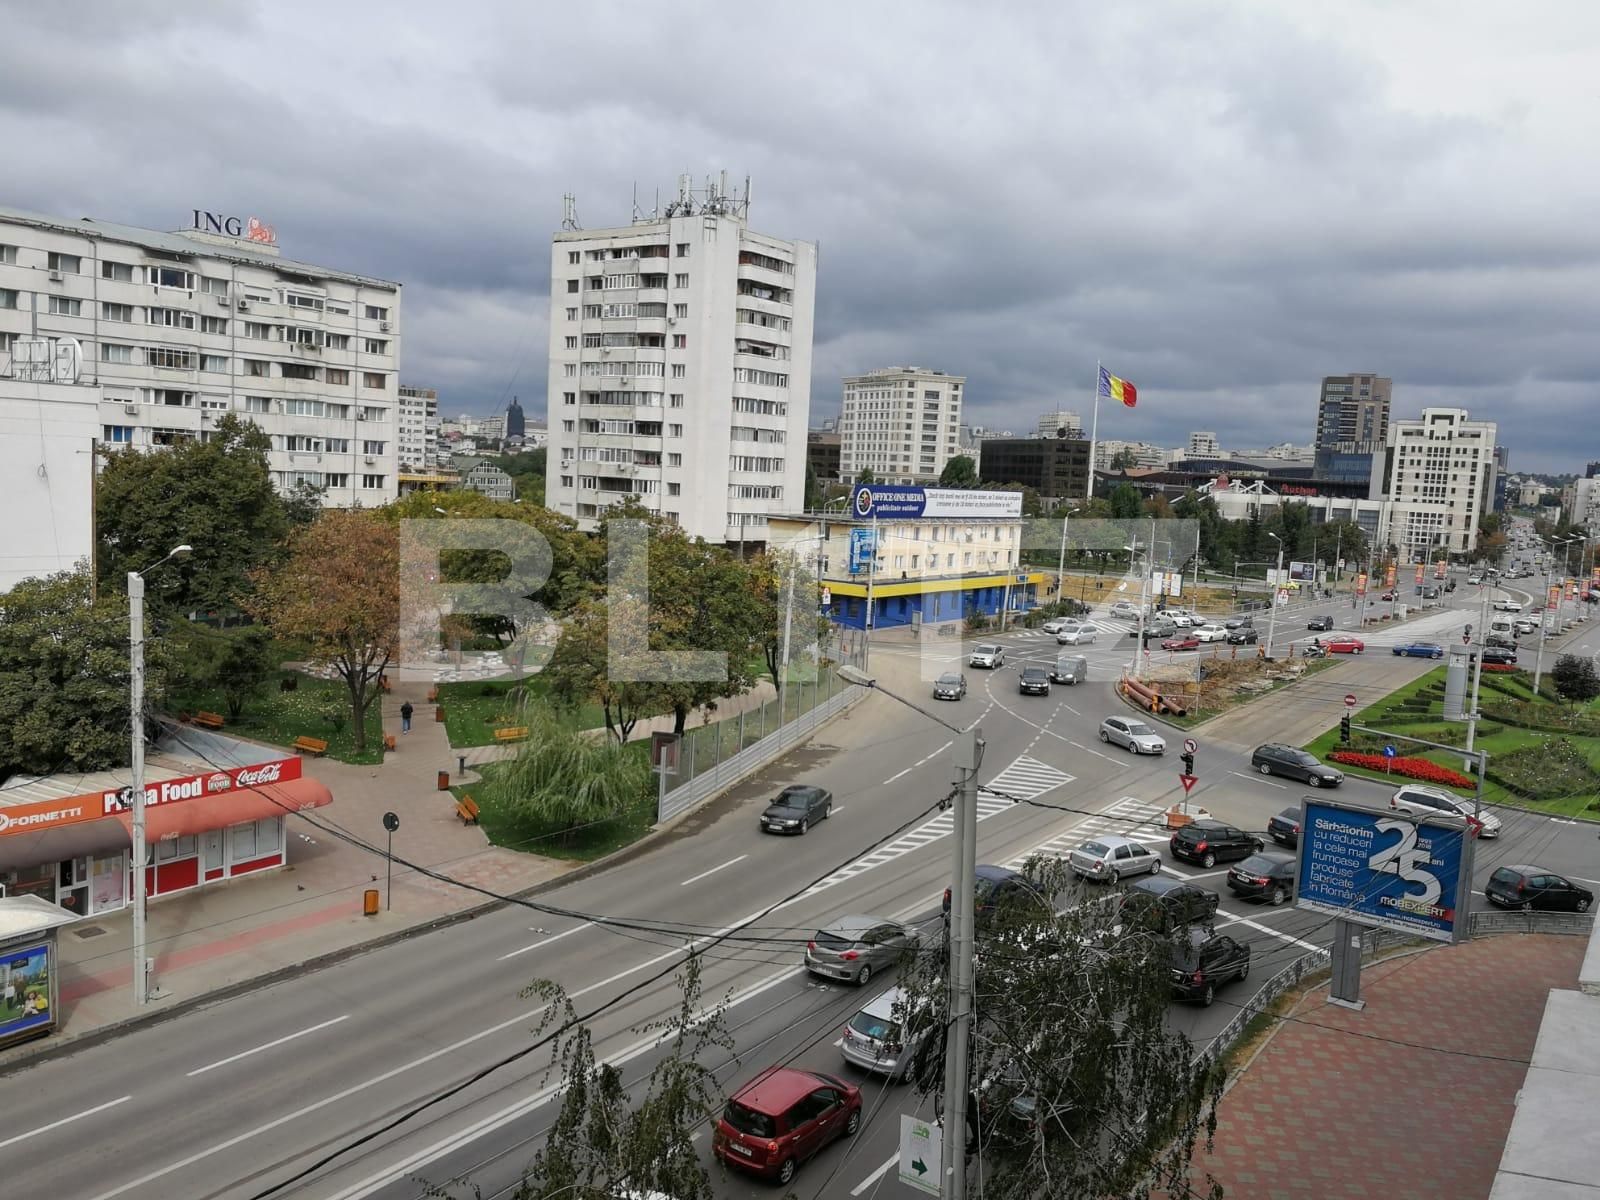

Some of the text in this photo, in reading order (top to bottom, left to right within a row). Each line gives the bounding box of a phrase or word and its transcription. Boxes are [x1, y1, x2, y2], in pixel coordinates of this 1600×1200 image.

[192, 209, 242, 237] ING
[1281, 483, 1318, 496] Auchan
[236, 763, 282, 787] Coca-Cola
[162, 778, 203, 802] Food
[9, 807, 82, 828] FORNETTI
[1313, 839, 1368, 859] la cele mai
[1314, 831, 1372, 849] cu reduceri
[1312, 850, 1360, 868] frumoase
[1368, 817, 1442, 905] 25
[1431, 858, 1444, 867] ani
[1311, 862, 1354, 878] produse
[1310, 871, 1354, 889] fabricate
[1320, 884, 1366, 903] România
